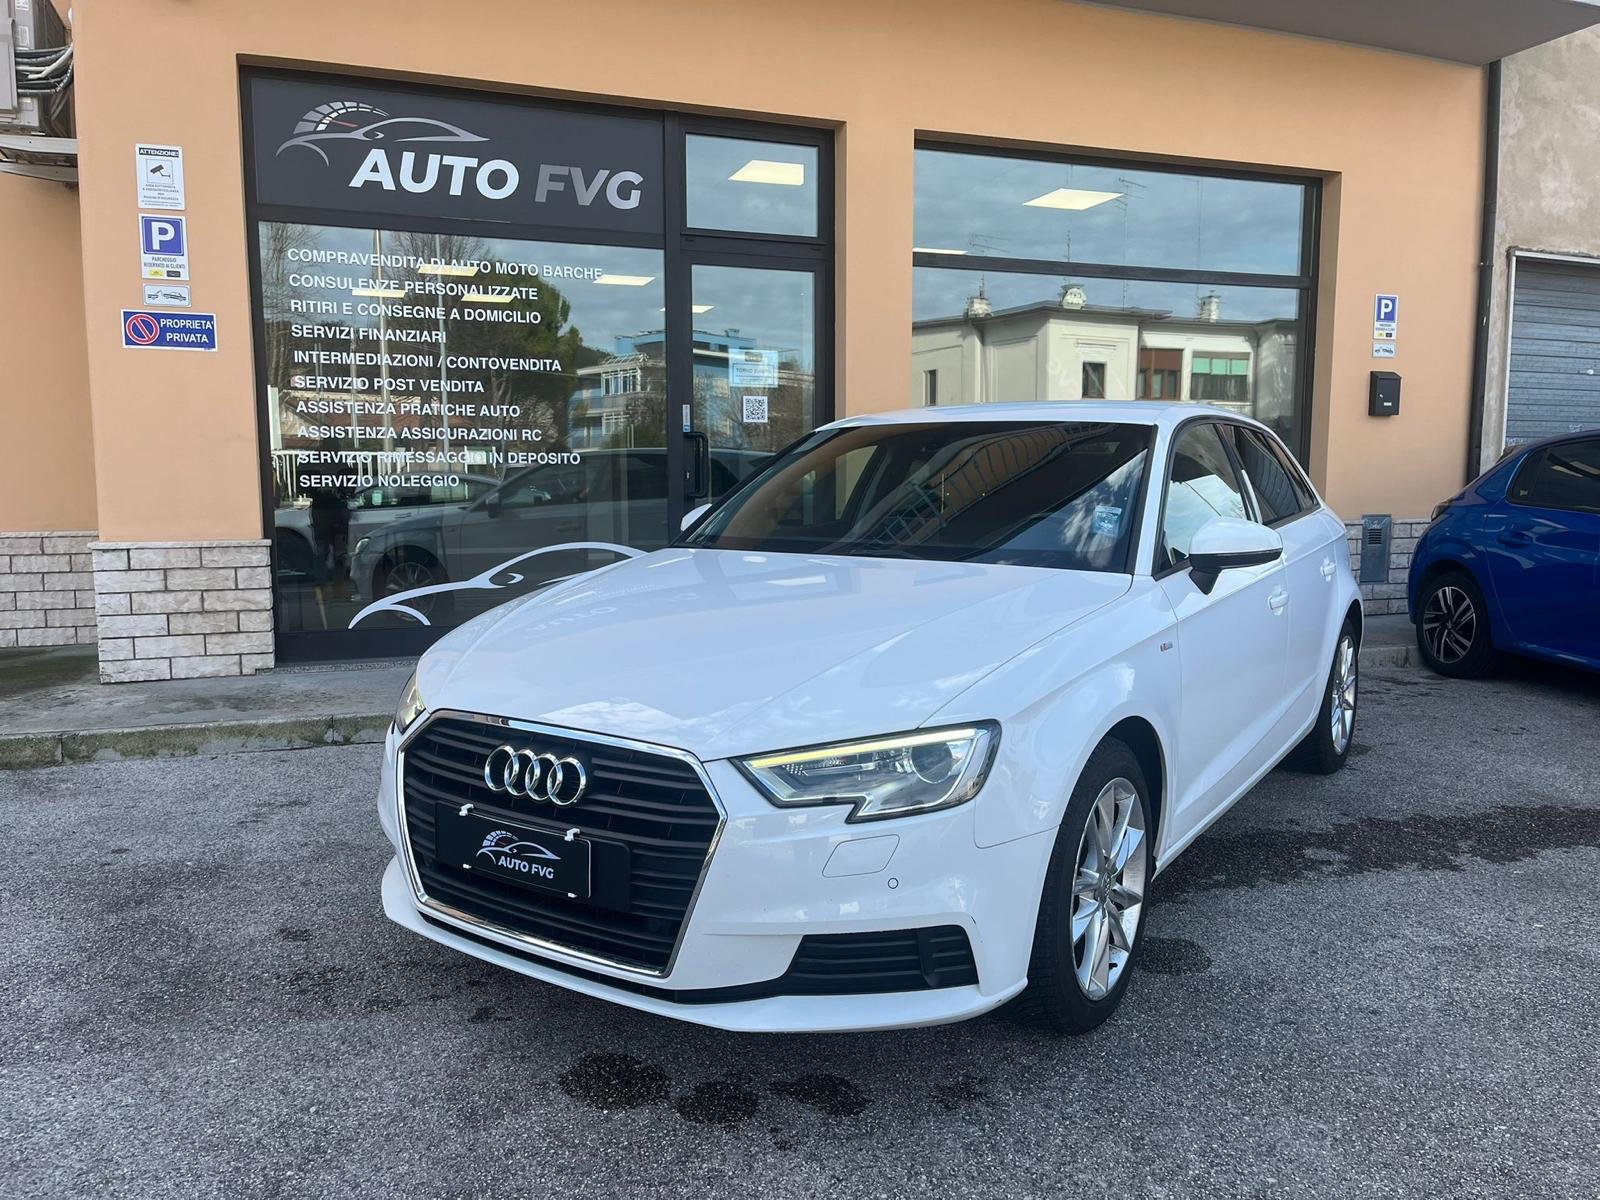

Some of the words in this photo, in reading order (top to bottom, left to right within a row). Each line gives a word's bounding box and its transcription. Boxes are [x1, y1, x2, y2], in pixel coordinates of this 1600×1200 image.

[348, 147, 520, 200] AUTO
[533, 163, 644, 210] FVG
[151, 221, 175, 250] P
[287, 248, 426, 269] COMPRAVENDITA
[430, 258, 445, 270] DI
[450, 259, 492, 274] AUTO
[496, 261, 539, 276] MOTO
[543, 264, 603, 279] BARCHE
[288, 273, 400, 291] CONSULENZE
[404, 281, 538, 300] PERSONALIZZATE
[290, 299, 338, 314] RITIRI
[344, 302, 352, 315] E
[357, 303, 446, 319] CONSEGNE
[449, 308, 461, 319] A
[464, 308, 542, 324] DOMICILIO
[1380, 298, 1393, 319] P
[160, 318, 214, 331] PROPRIETA'
[291, 324, 354, 339] SERVIZI
[359, 327, 447, 343] FINANZIARI
[166, 332, 209, 344] PRIVATA
[294, 349, 434, 367] INTERMEDIAZIONI
[437, 354, 443, 368] /
[446, 356, 562, 372] CONTOVENDITA
[294, 375, 370, 390] SERVIZIO
[374, 378, 416, 391] POST
[420, 379, 485, 393] VENDITA
[296, 400, 397, 415] ASSISTENZA
[400, 402, 476, 416] PRATICHE
[479, 403, 521, 417] AUTO
[297, 425, 397, 439] ASSISTENZA
[400, 427, 518, 441] ASSICURAZIONI
[522, 428, 542, 441] RC
[298, 450, 372, 464] SERVIZIO
[376, 451, 486, 465] RIMESSAGGIO
[489, 451, 504, 464] IN
[507, 452, 581, 465] DEPOSITO
[299, 474, 373, 487] SERVIZIO
[377, 474, 460, 487] NOLEGGIO
[498, 856, 529, 873] AUTO
[531, 863, 554, 880] FVG
